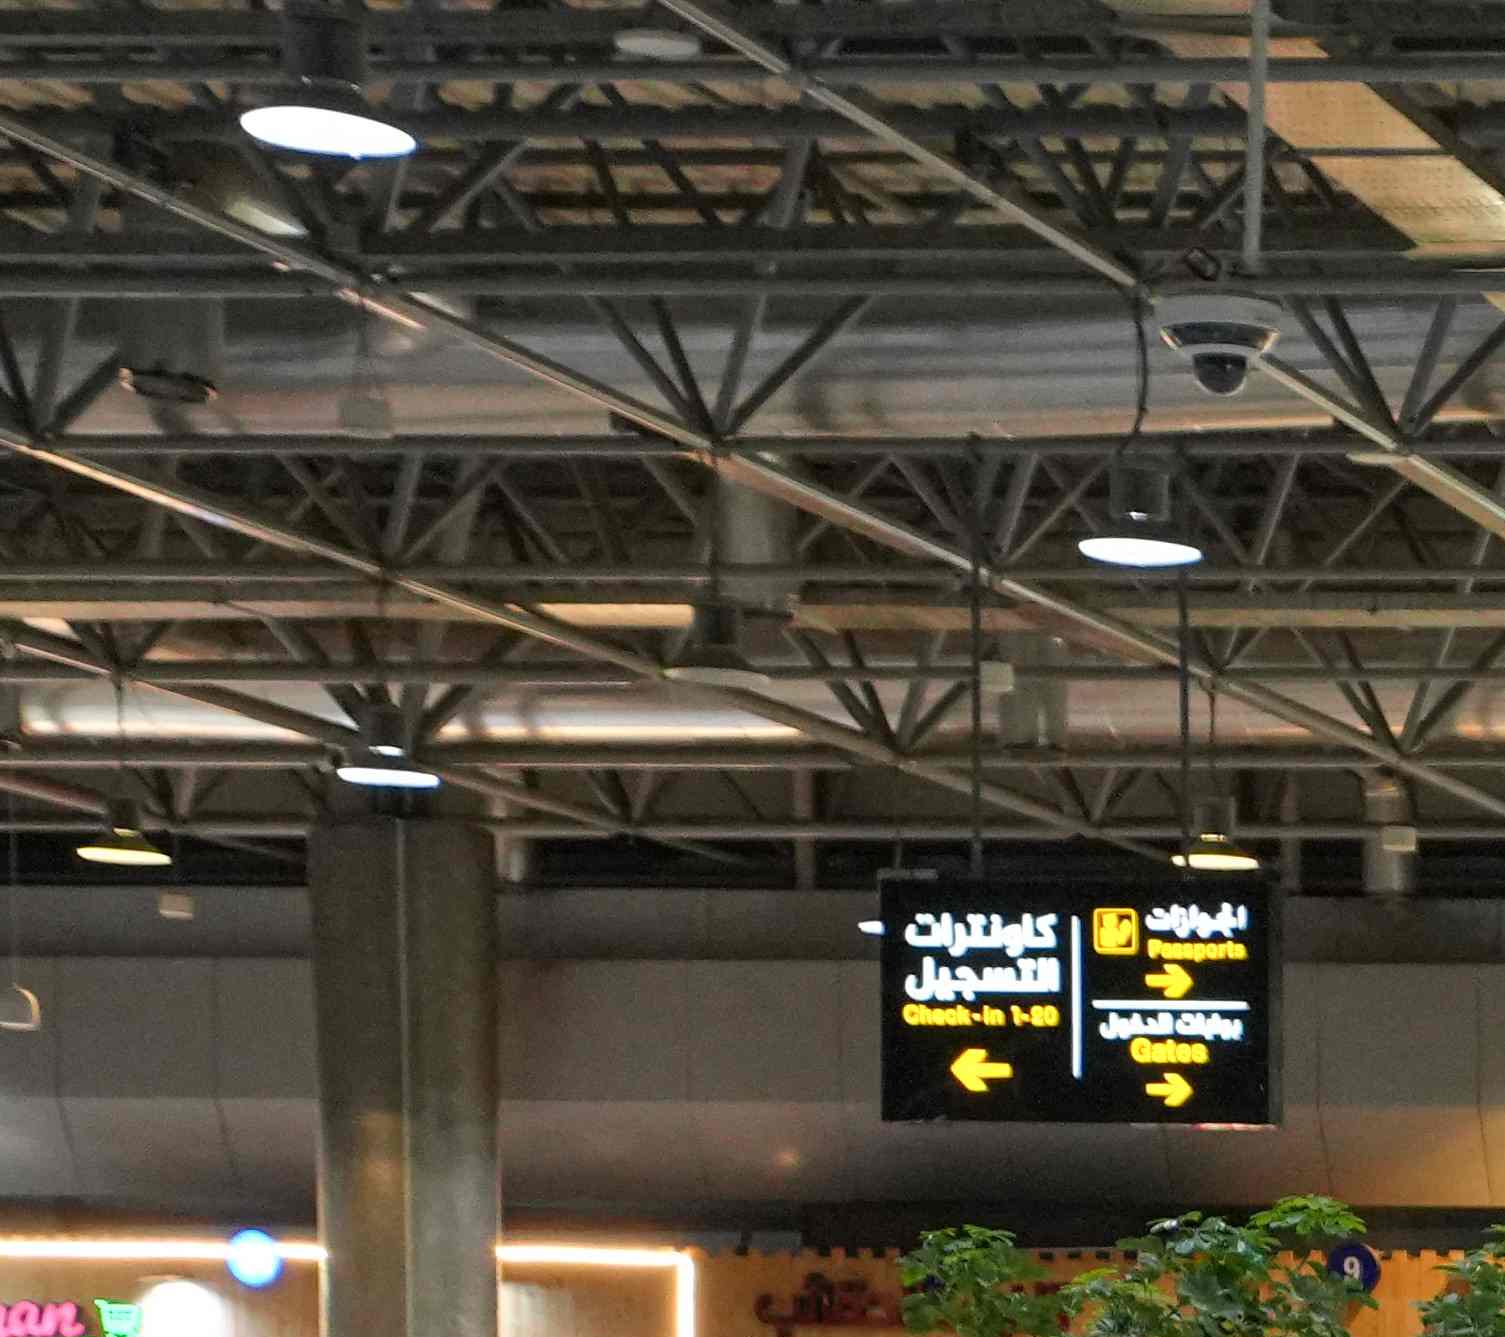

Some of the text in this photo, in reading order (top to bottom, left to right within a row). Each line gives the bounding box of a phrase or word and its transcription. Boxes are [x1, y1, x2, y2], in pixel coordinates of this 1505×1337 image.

[904, 912, 1058, 958] كاونترات
[1147, 938, 1247, 963] Passports
[904, 955, 1060, 1002] التسجيل
[902, 1003, 1060, 1027] Check-in 1-20
[1130, 1036, 1211, 1064] Gates
